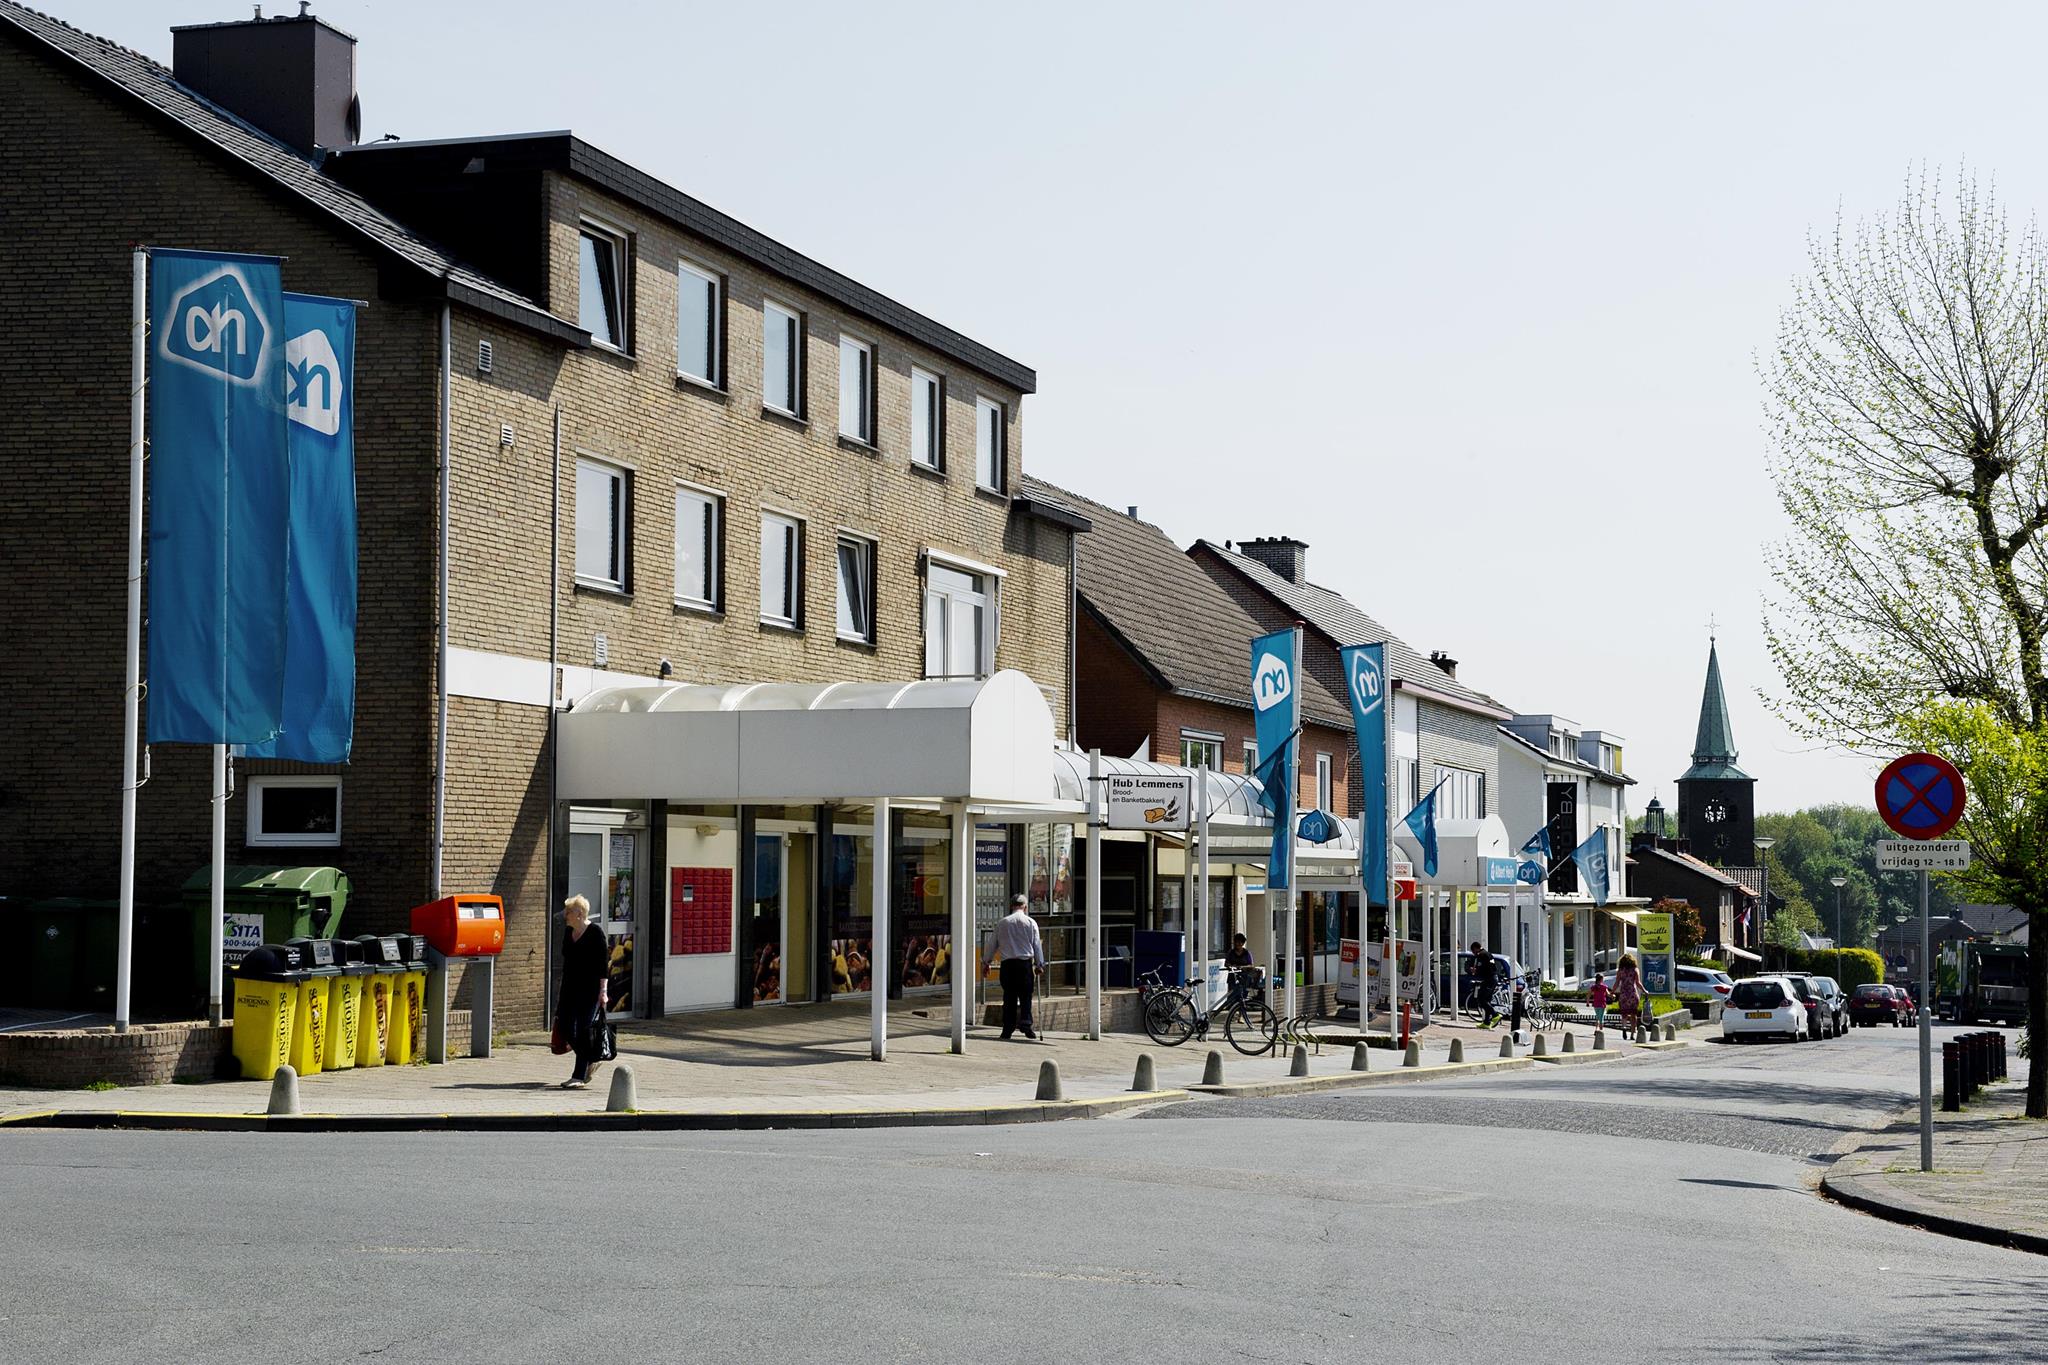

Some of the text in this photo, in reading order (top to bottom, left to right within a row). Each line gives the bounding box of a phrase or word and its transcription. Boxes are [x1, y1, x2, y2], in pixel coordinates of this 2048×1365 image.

[186, 301, 246, 355] ah
[1112, 778, 1184, 789] Hub Lemmens
[1121, 797, 1166, 805] Banketbakkerij
[1886, 842, 1960, 854] uitgezonderd
[1881, 856, 1920, 868] vrijdag
[1924, 858, 1933, 866] 12
[1944, 858, 1955, 866] 18
[1958, 857, 1965, 866] h
[1521, 867, 1536, 879] ah
[231, 925, 261, 938] SITA
[1402, 980, 1416, 991] 0.99
[343, 983, 354, 1059] SCHOENEN
[280, 992, 288, 1066] SCHOENE
